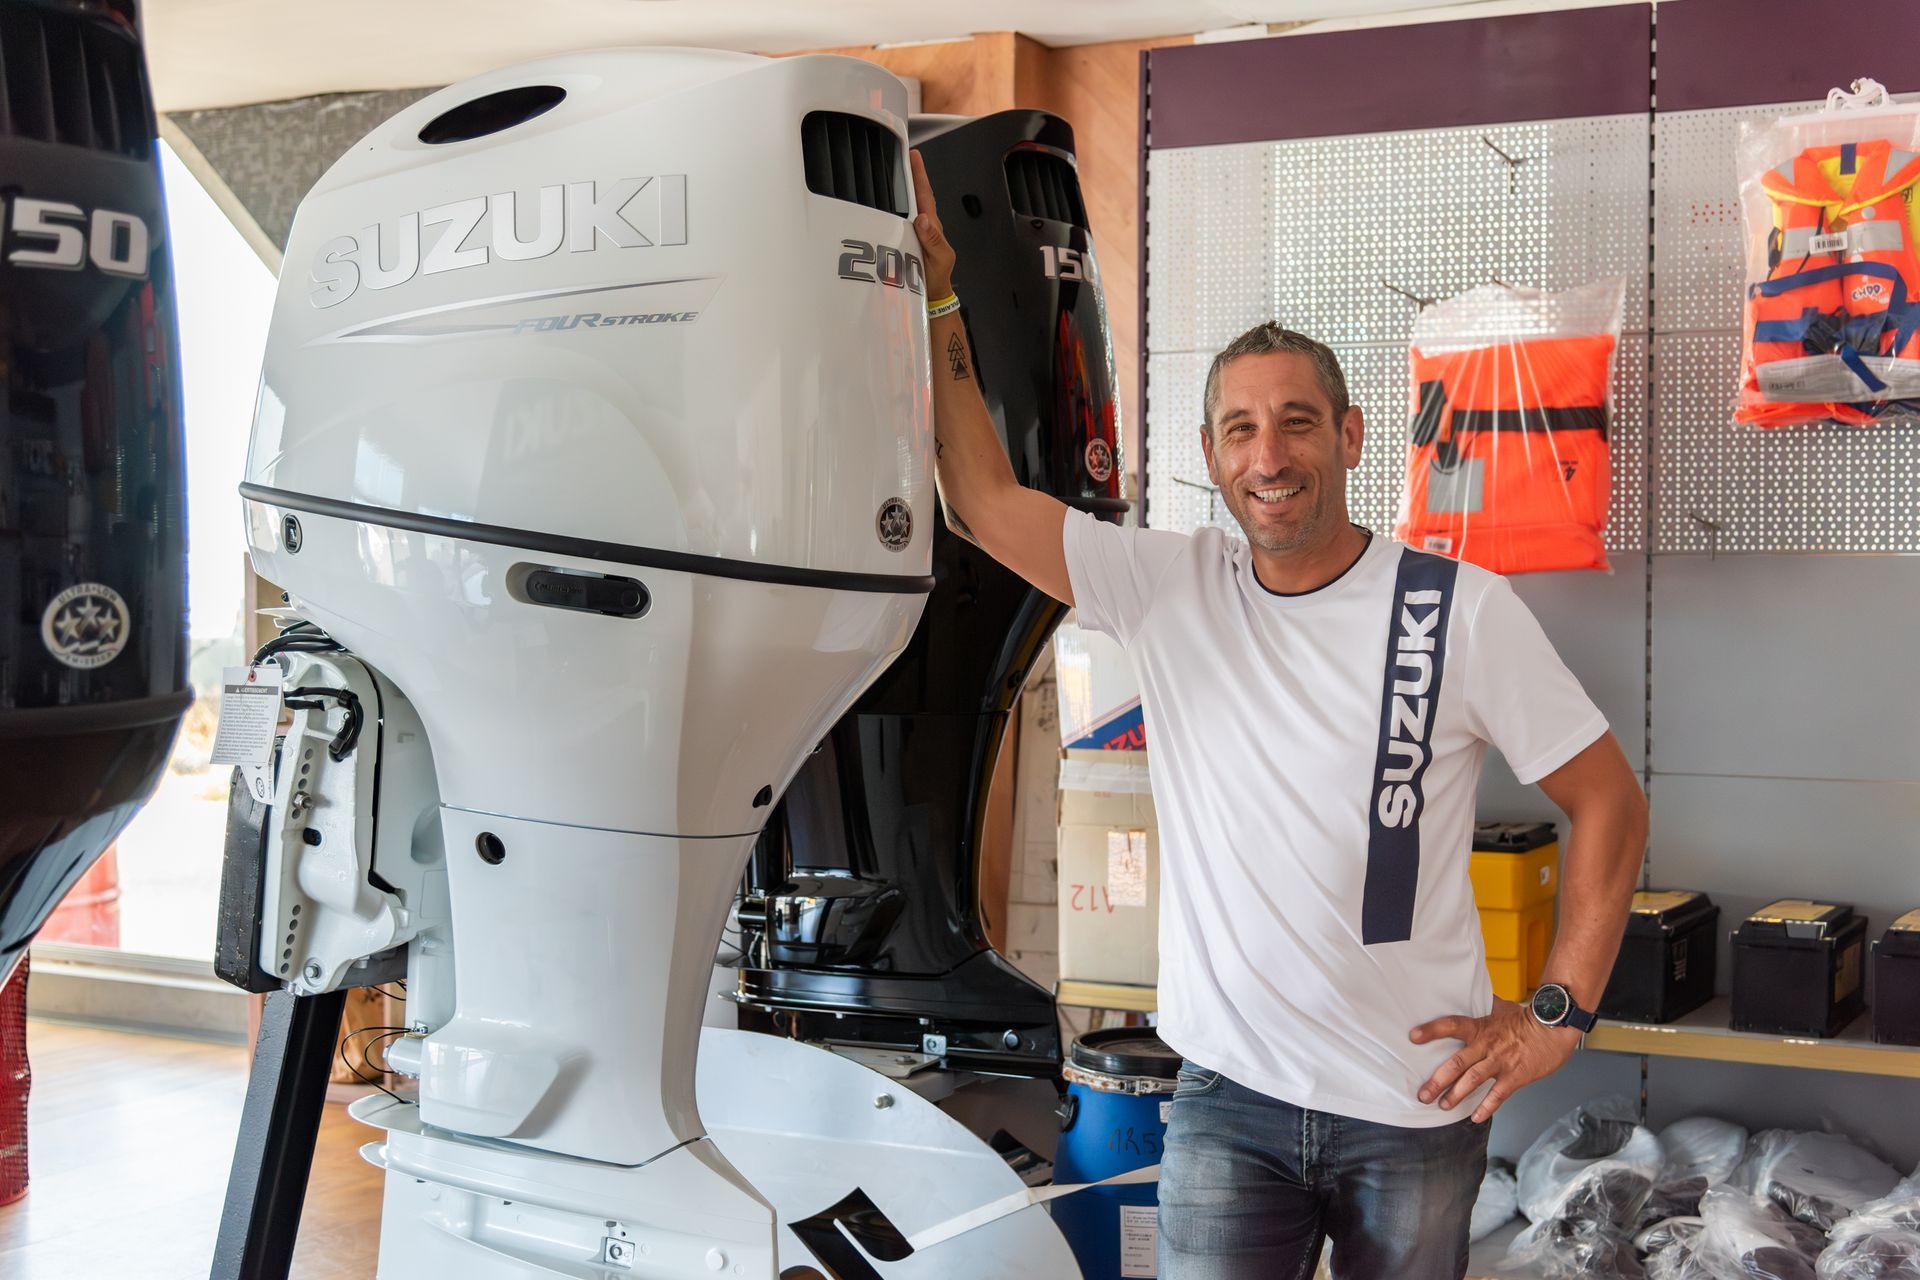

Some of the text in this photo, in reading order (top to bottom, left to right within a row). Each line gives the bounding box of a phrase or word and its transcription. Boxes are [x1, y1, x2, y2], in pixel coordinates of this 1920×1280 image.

[0, 197, 149, 280] 50
[308, 173, 688, 309] SUZUKI
[838, 239, 924, 296] 200
[513, 311, 699, 335] FOUR STROKE
[1377, 589, 1443, 829] SUZUKI
